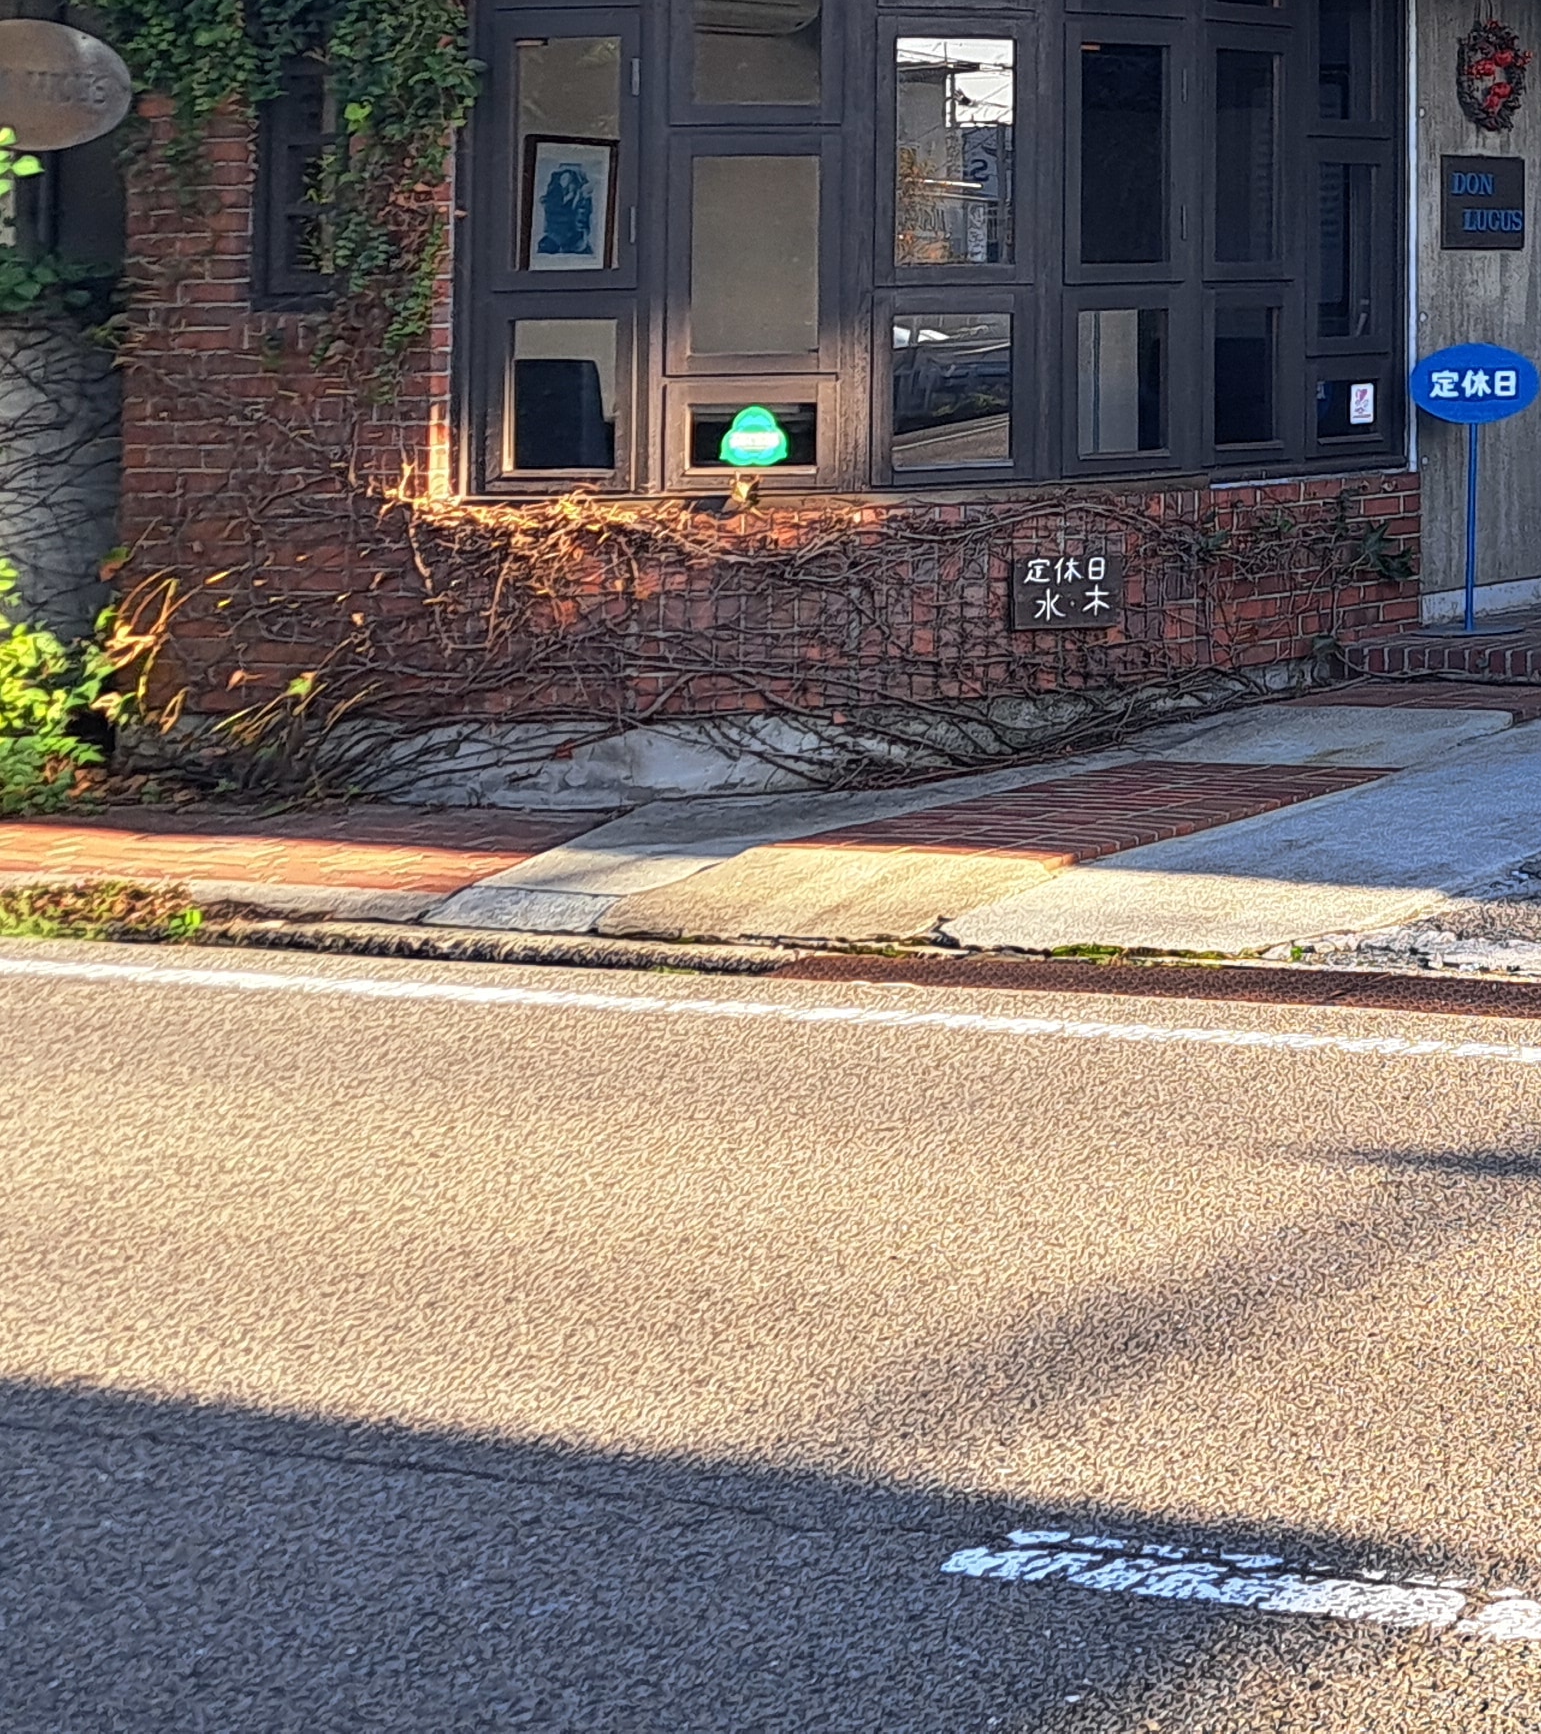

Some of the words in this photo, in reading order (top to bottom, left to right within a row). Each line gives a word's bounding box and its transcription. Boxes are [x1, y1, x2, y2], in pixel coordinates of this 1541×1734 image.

[1451, 172, 1494, 195] DON
[1463, 209, 1523, 231] LUCUS
[1429, 369, 1516, 398] 定休日
[1023, 557, 1105, 584] 定休日
